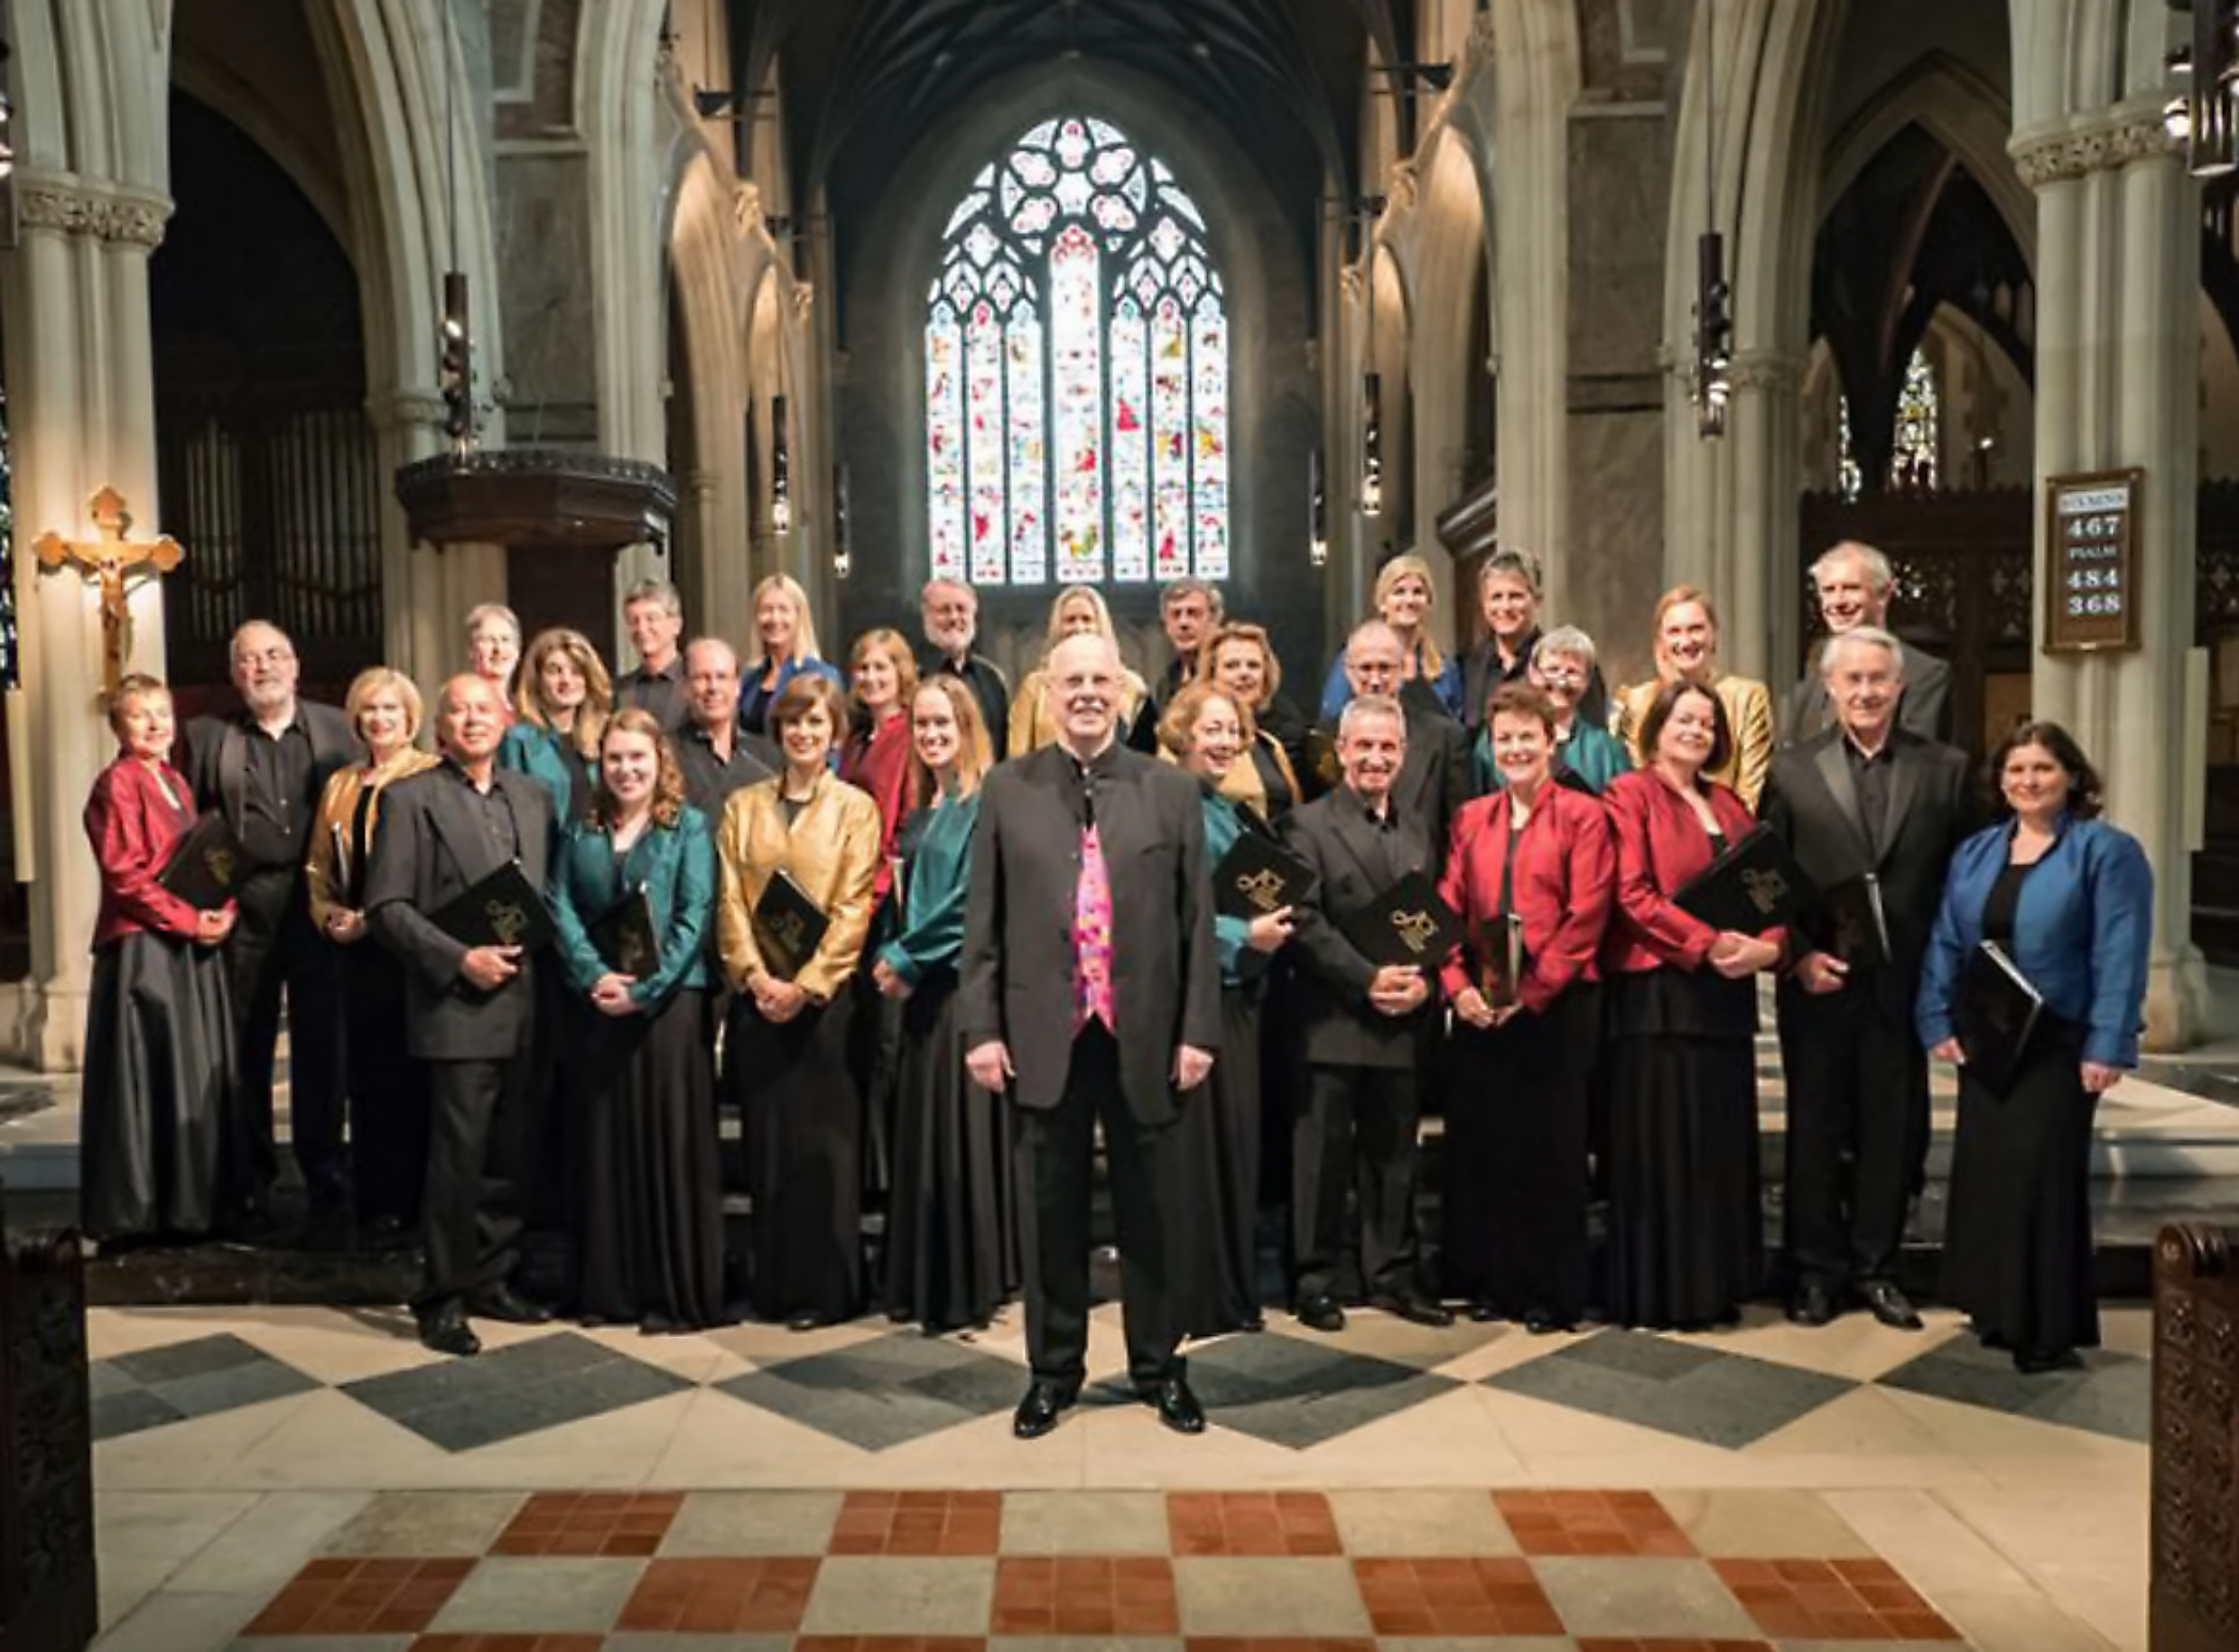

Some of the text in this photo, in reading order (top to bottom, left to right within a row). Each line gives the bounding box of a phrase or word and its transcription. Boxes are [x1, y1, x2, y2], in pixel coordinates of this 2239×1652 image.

[2067, 517, 2119, 537] 467
[2067, 568, 2118, 589] 484
[2068, 594, 2120, 614] 368
